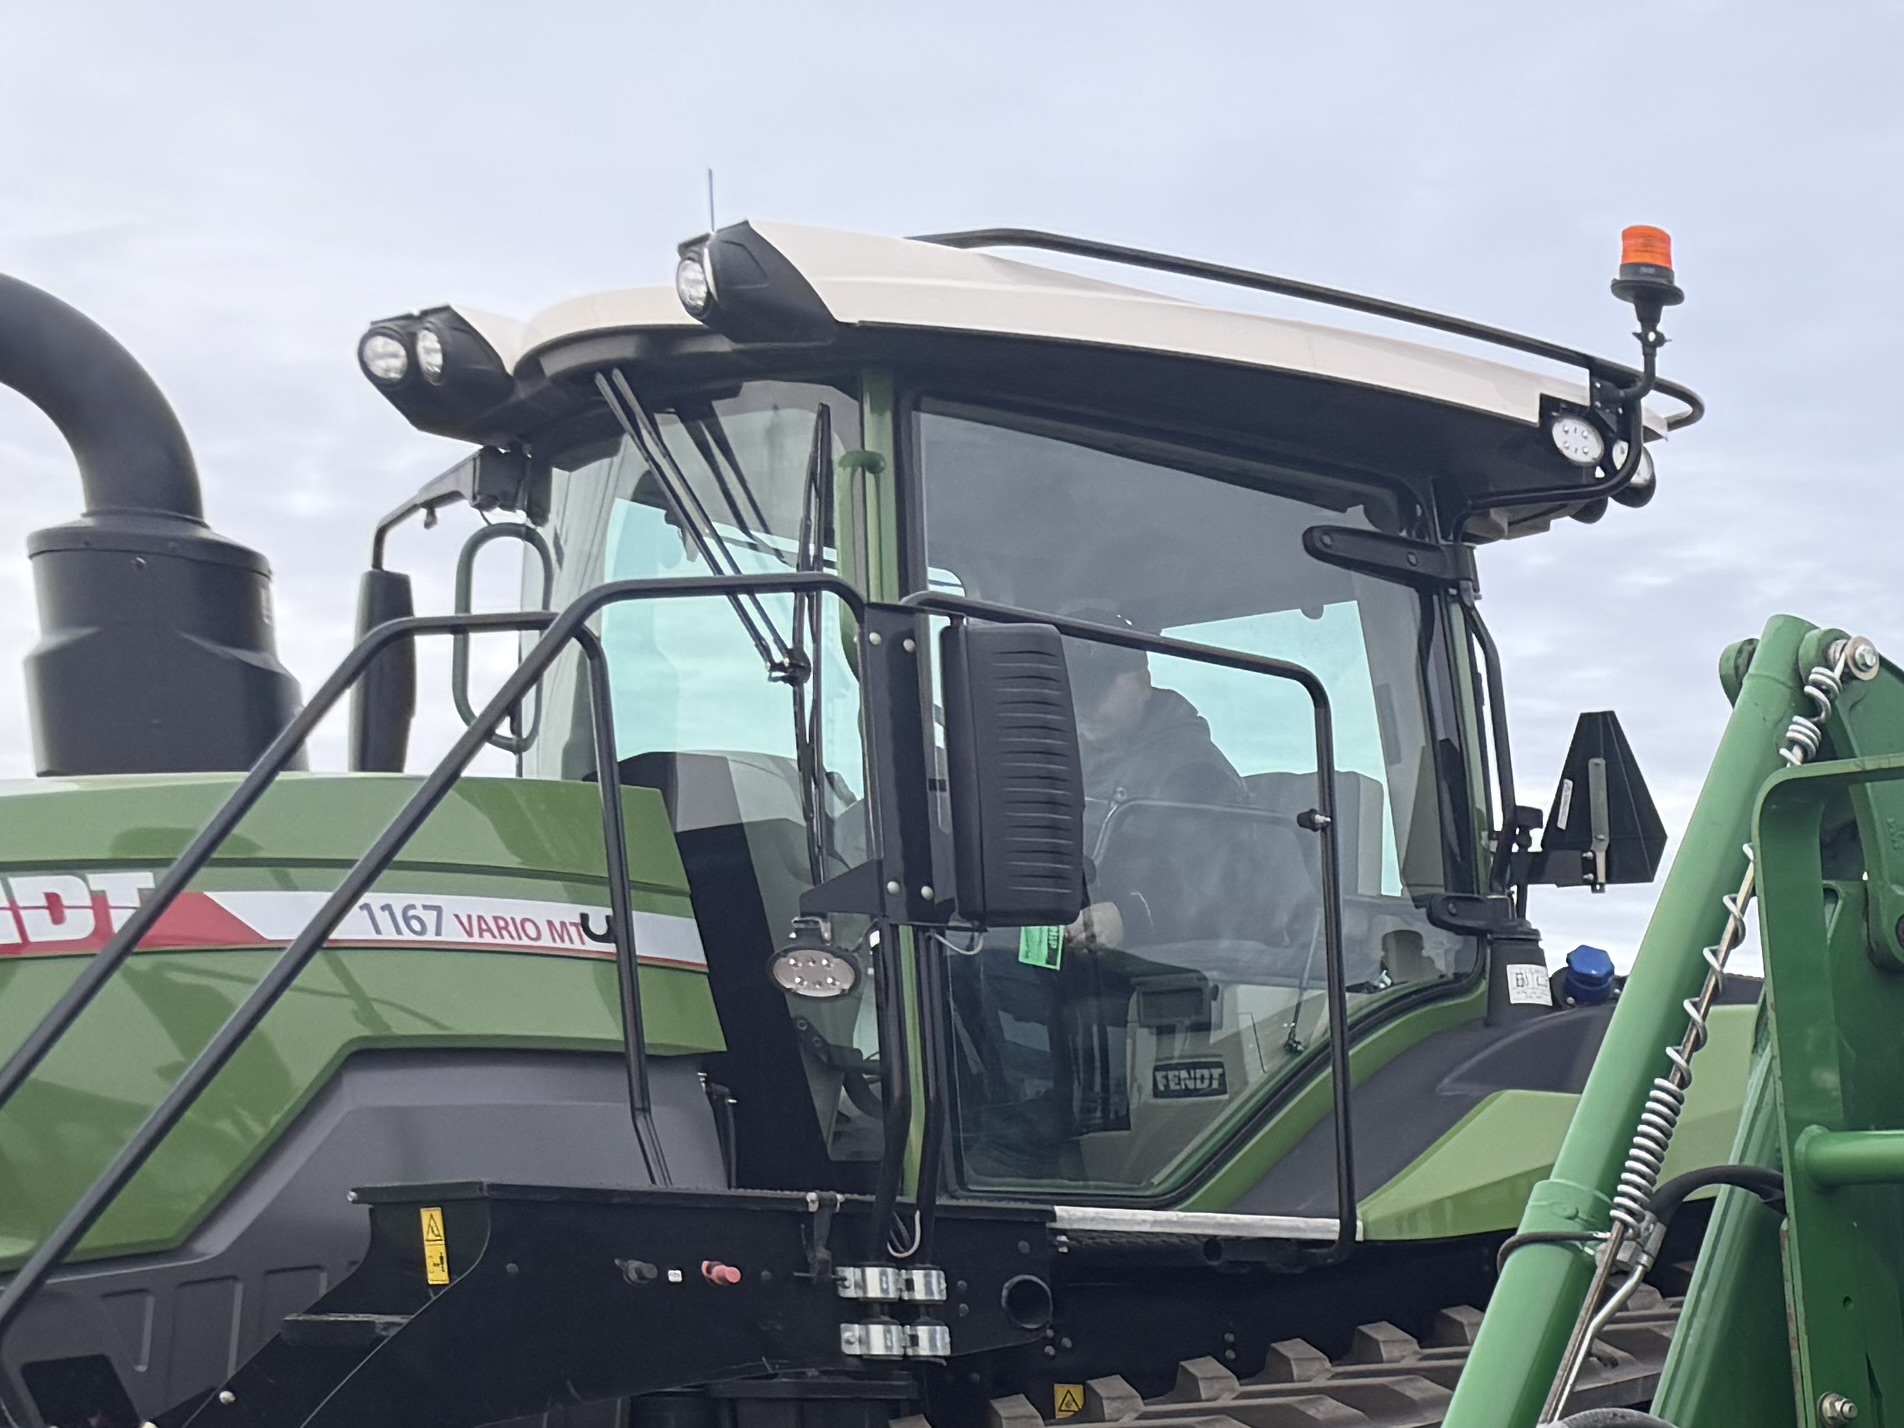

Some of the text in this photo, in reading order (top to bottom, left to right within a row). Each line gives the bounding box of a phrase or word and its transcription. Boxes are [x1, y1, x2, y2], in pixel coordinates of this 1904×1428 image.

[358, 902, 587, 946] 1167 VARIO MT
[1155, 1068, 1224, 1092] FENDT
